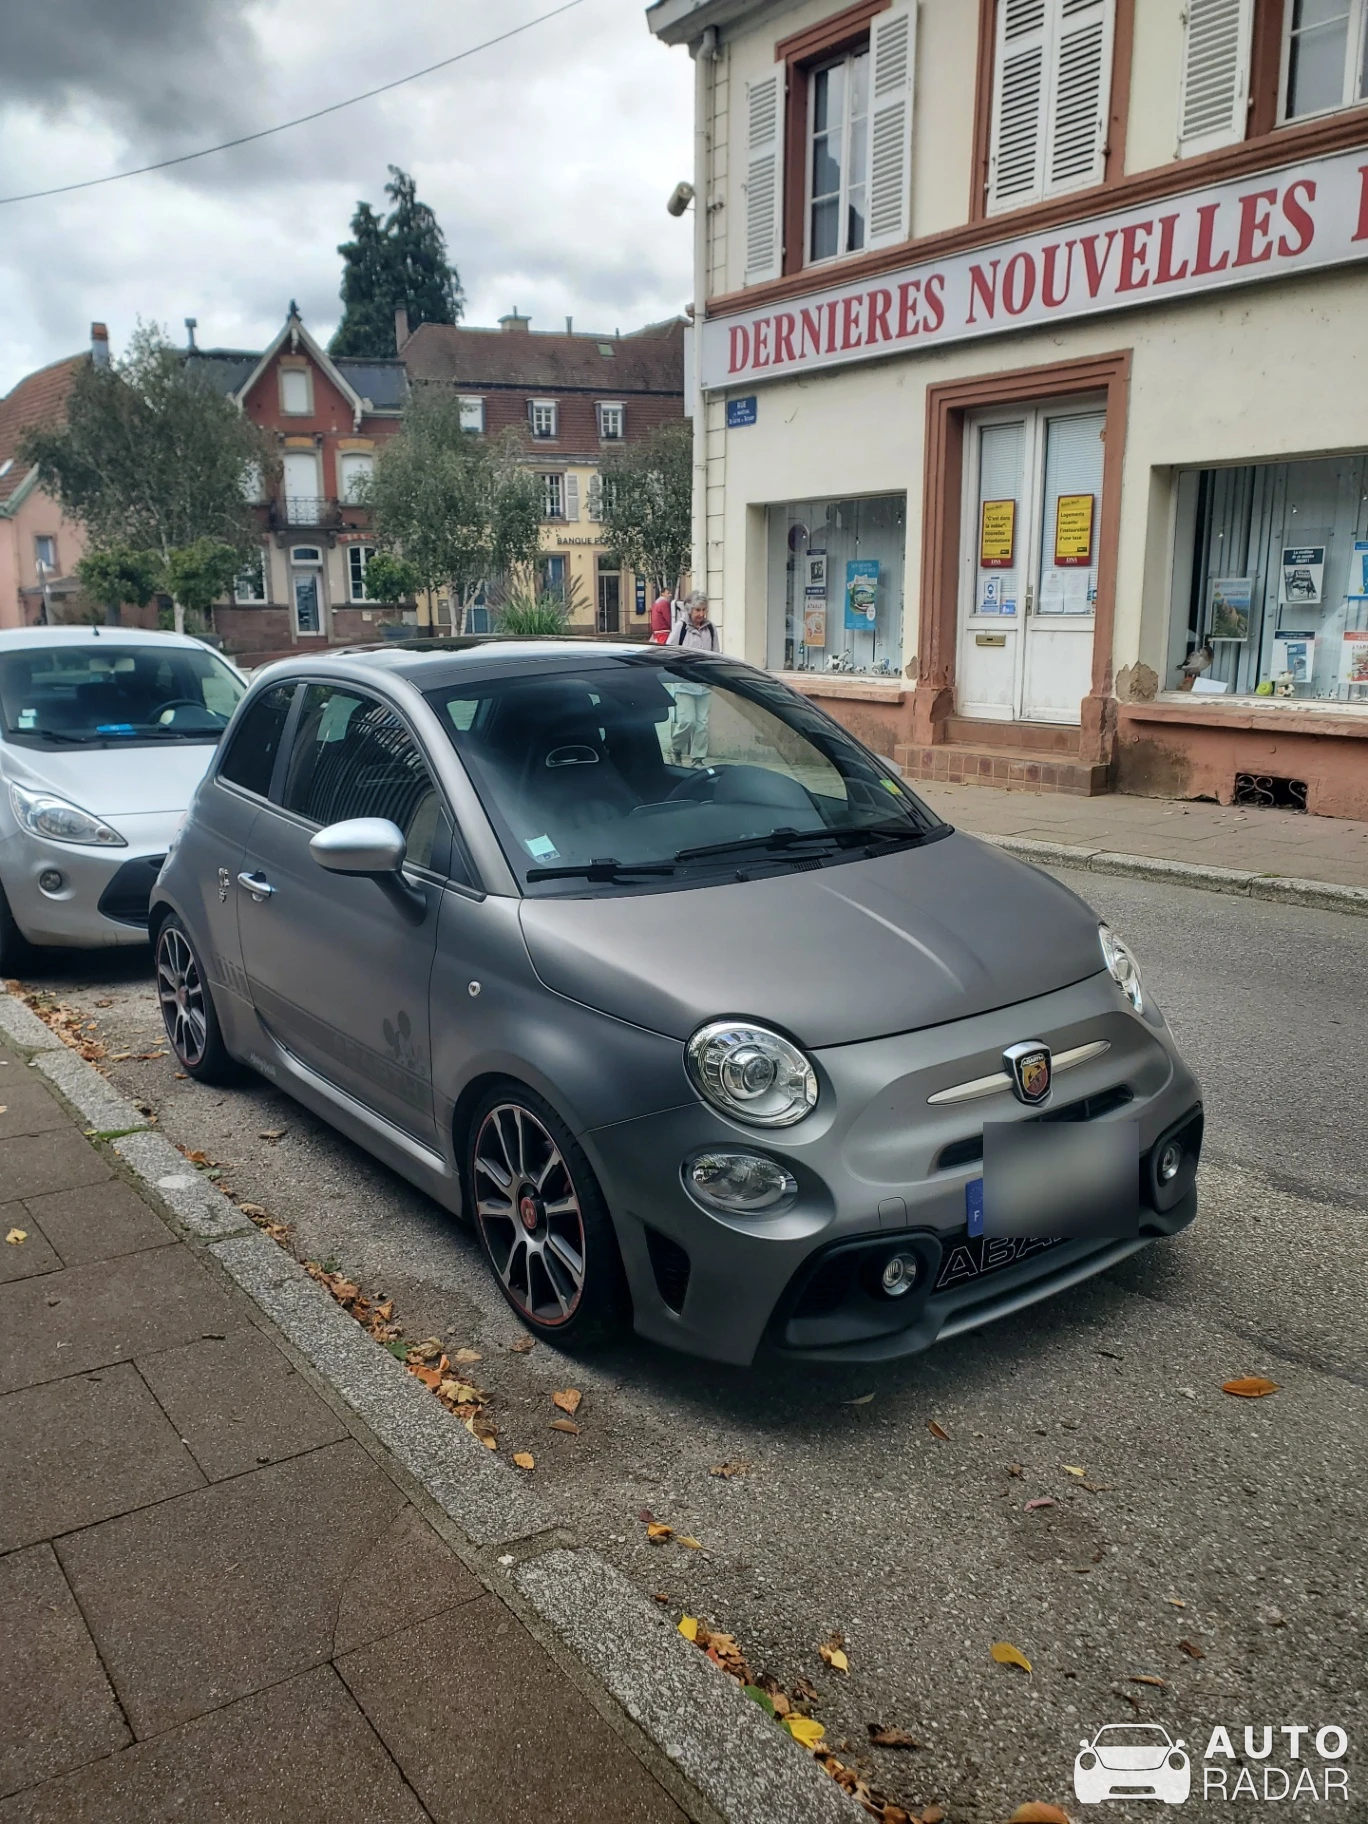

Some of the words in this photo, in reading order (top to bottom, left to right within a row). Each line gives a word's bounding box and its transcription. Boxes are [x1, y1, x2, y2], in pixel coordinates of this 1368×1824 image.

[728, 273, 945, 374] DERNIERES
[965, 179, 1317, 324] NOUVELLES
[557, 537, 593, 545] BANQUE
[1022, 1055, 1044, 1066] ABARTH
[974, 1211, 980, 1222] F
